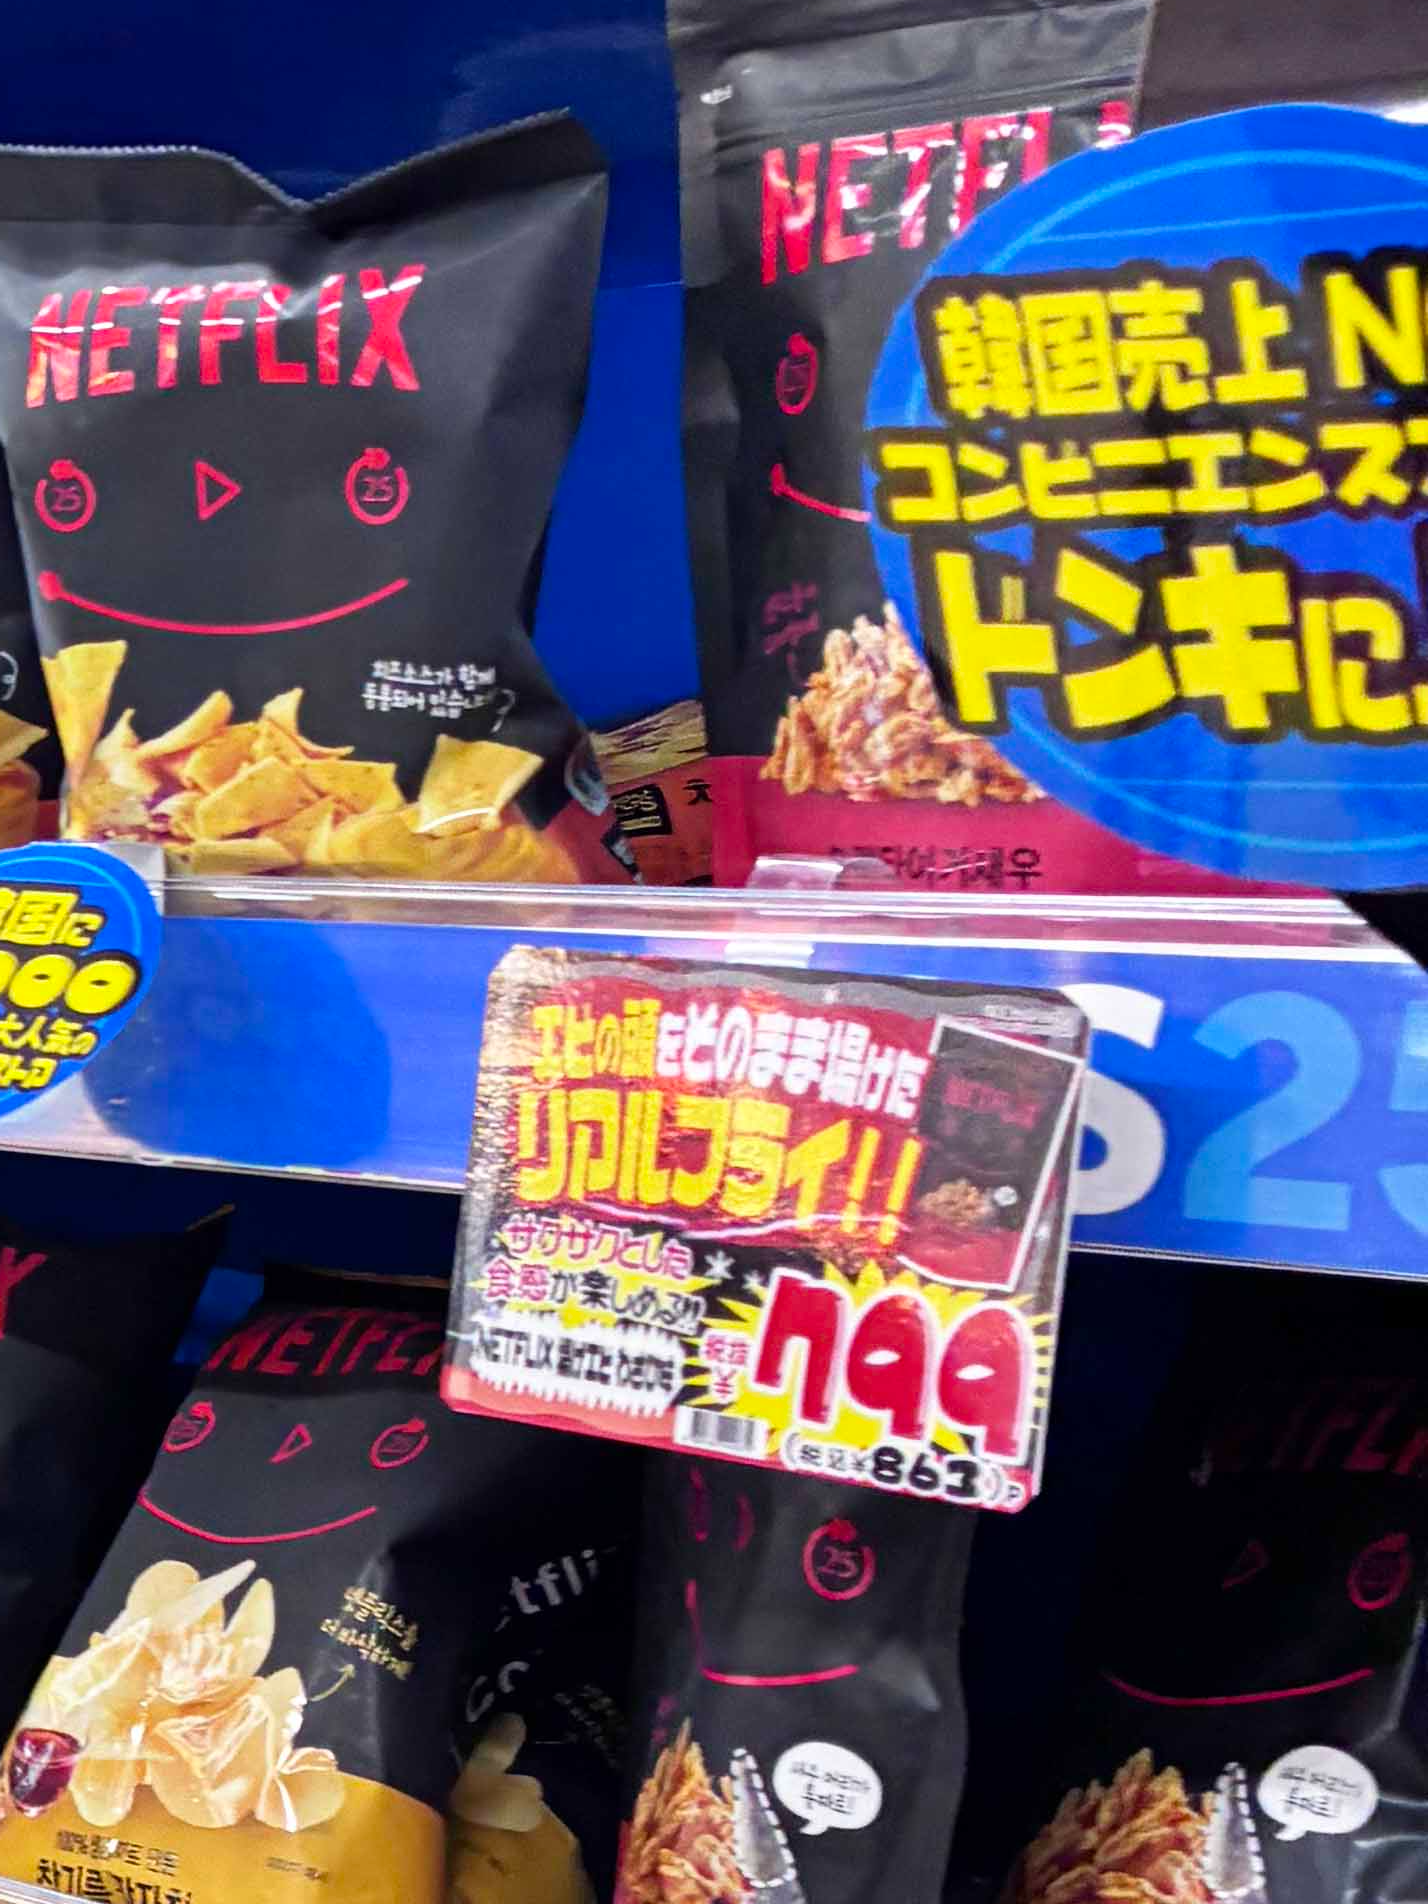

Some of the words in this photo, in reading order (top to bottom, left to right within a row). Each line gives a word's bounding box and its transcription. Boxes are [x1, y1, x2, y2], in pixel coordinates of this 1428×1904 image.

[26, 264, 428, 409] NETFLIX
[935, 274, 1306, 421] 韓国売上
[880, 419, 1428, 526] コンビニエンス
[935, 545, 1428, 736] ドンキに
[531, 998, 930, 1118] エビの頭をそのまま揚げた
[475, 1329, 555, 1370] NETFLIX
